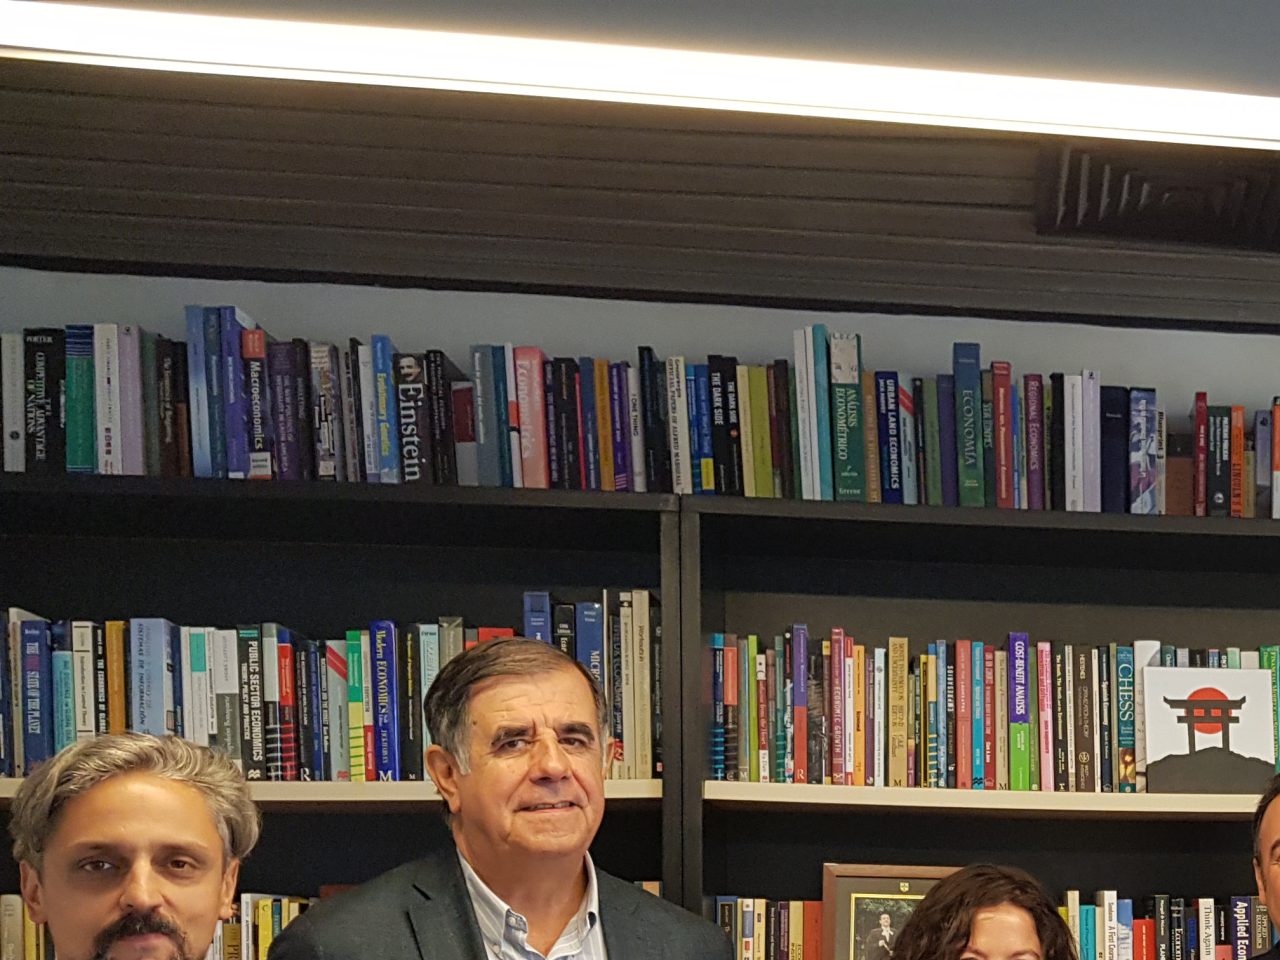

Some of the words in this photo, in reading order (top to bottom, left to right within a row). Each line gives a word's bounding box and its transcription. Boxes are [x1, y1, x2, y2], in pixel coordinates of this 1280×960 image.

[377, 373, 388, 420] Evolutionary
[712, 372, 721, 385] THE
[887, 379, 897, 410] URBAN
[26, 395, 36, 433] NATIONS
[249, 361, 264, 450] Macroeconomics
[516, 360, 535, 458] Econometrics
[713, 387, 722, 407] DARK
[846, 388, 857, 427] ANÁLISIS
[398, 383, 426, 482] Einstein
[714, 408, 723, 425] SIDE
[836, 388, 848, 460] ECONOMÉTRICO
[888, 412, 897, 435] LAND
[962, 390, 977, 465] ECONOMÍA
[889, 437, 899, 489] ECONOMICS
[249, 641, 259, 672] PUBLIC
[375, 630, 386, 658] Modern
[27, 670, 40, 688] STATE
[138, 659, 145, 669] DE
[1015, 641, 1024, 684] COST-BENEFIT
[138, 672, 147, 726] INFORMACIÓN
[250, 674, 260, 708] SECTOR
[377, 660, 387, 713] ECONOMICS
[833, 686, 841, 722] ECONOMIC
[1015, 685, 1025, 715] ANALYSIS
[1119, 664, 1133, 721] CHESS
[28, 711, 40, 734] PLANET
[252, 710, 263, 761] ECONOMICS
[1204, 904, 1213, 930] Think
[1234, 901, 1249, 937] Applied
[1203, 932, 1213, 956] Again
